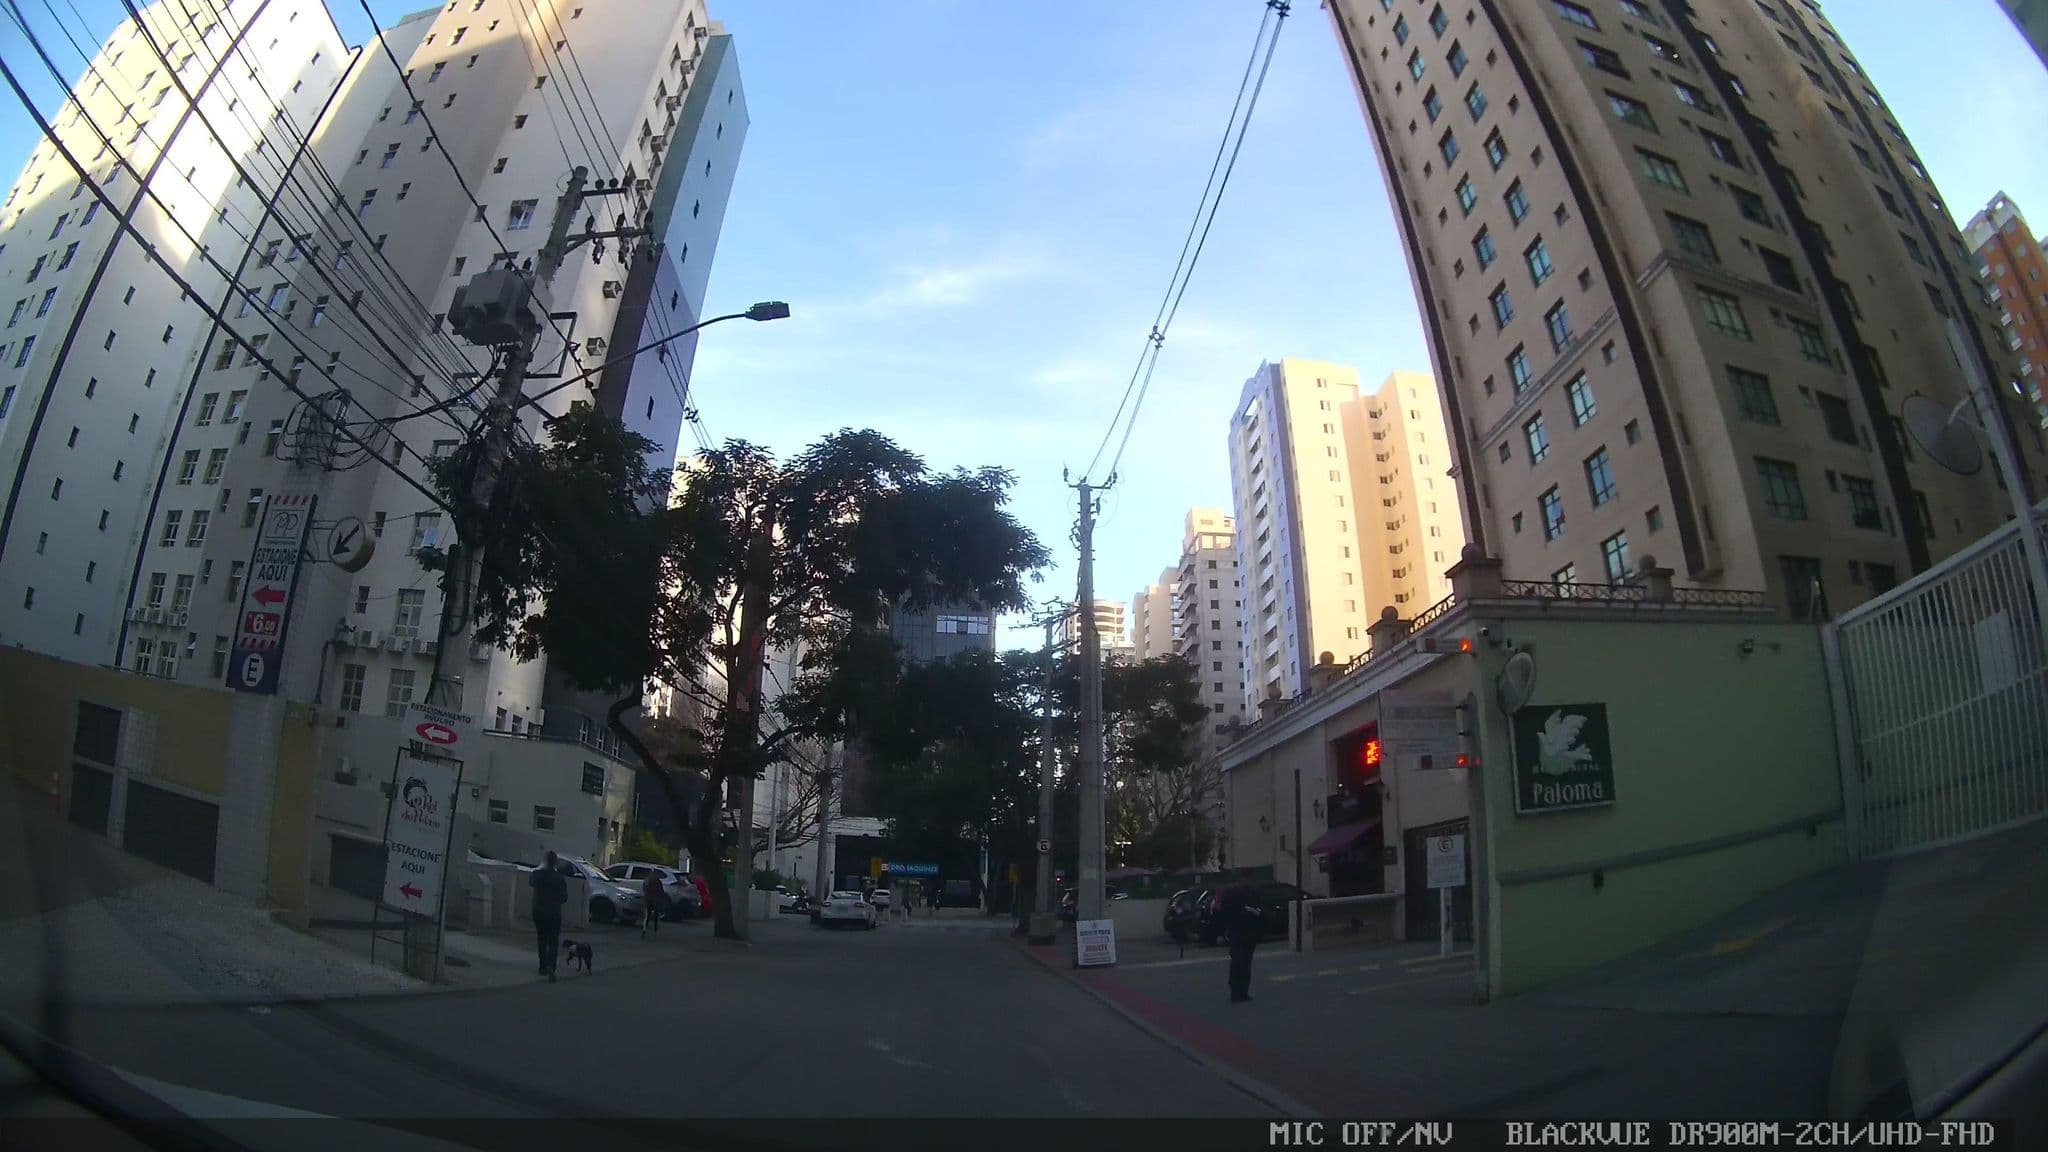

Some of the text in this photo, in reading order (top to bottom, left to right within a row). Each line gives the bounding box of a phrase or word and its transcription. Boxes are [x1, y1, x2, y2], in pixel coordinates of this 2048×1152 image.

[256, 548, 298, 565] ESTACIONE
[257, 564, 288, 581] AQUI
[246, 657, 260, 682] E
[411, 702, 471, 724] ESTACIONAMENTO
[1533, 782, 1603, 805] Paloma
[391, 842, 441, 863] ESTACIONE
[401, 861, 425, 875] AQUI
